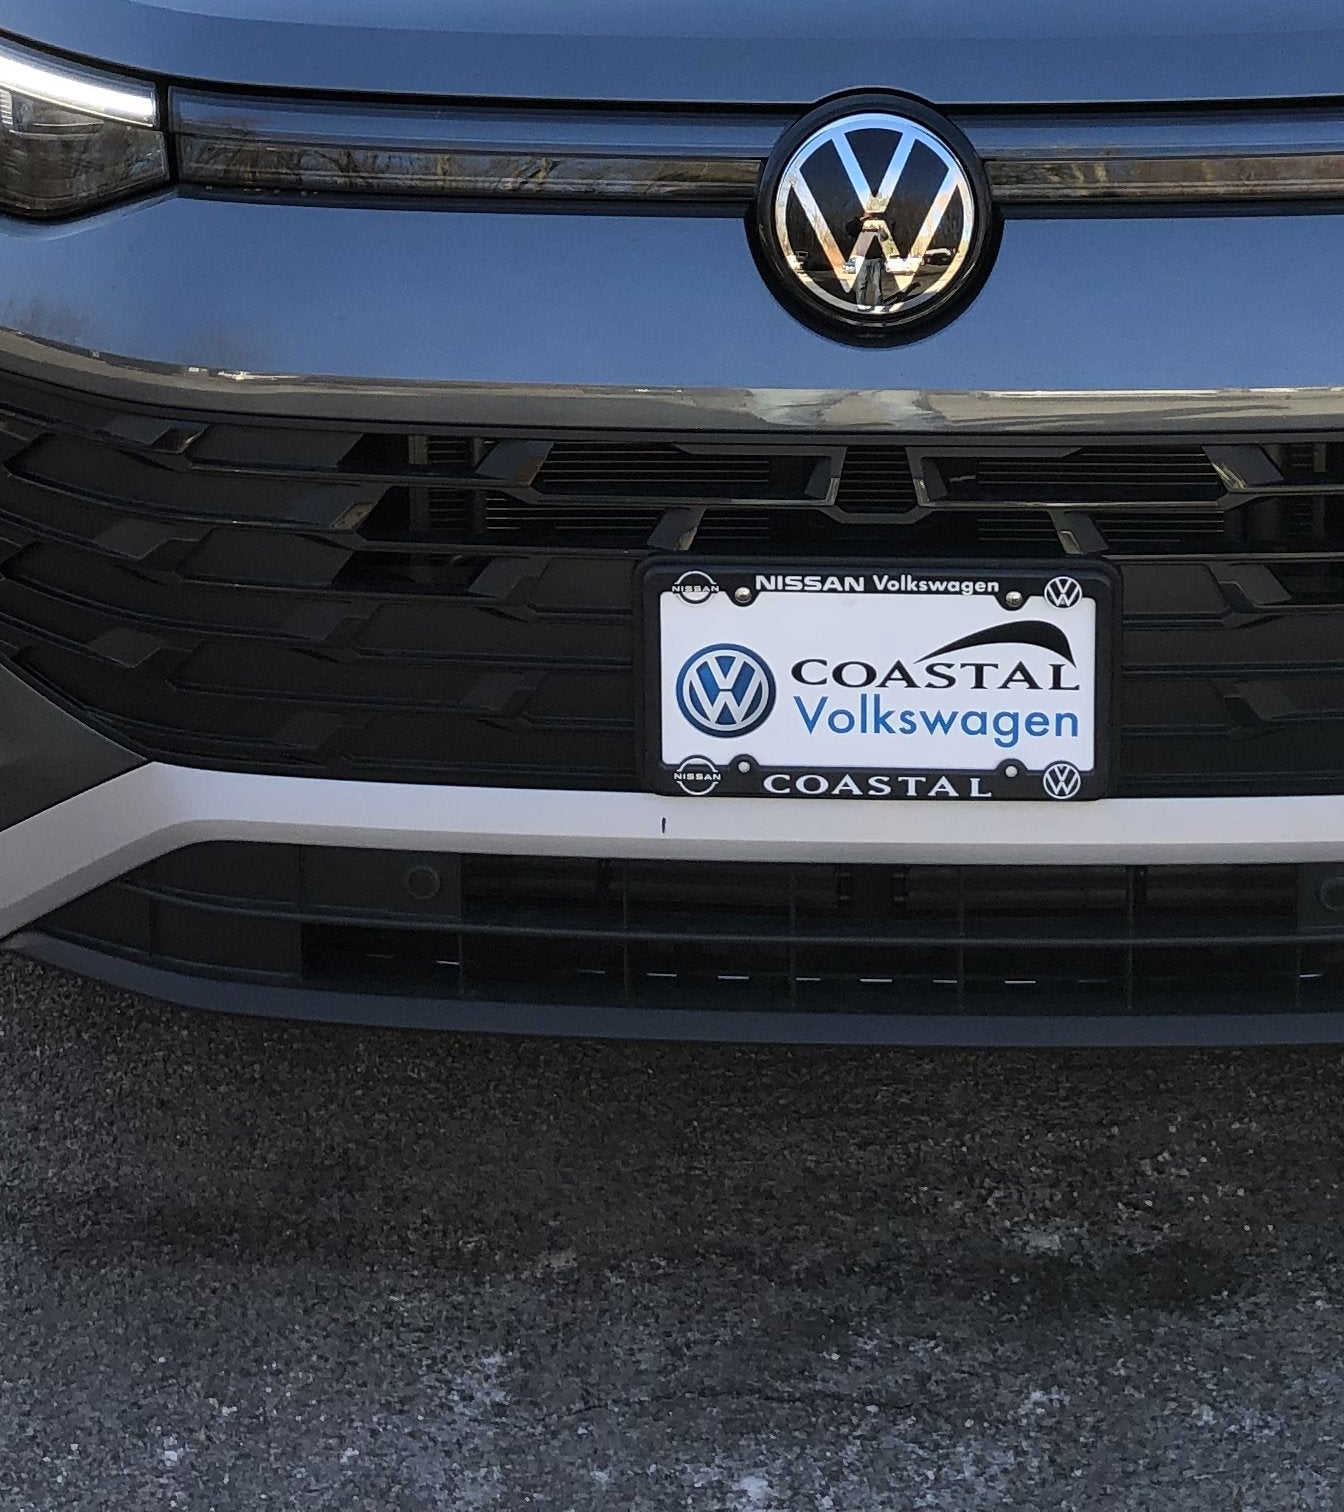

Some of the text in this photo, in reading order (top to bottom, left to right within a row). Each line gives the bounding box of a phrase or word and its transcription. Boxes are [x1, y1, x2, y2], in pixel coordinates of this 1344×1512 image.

[671, 584, 720, 593] NISSAN
[755, 574, 1000, 596] NISSAN Volkswagen
[791, 658, 1080, 691] COASTAL
[792, 692, 1080, 748] Volkswagen
[673, 772, 722, 782] NISSAN
[763, 773, 992, 798] COASTAL
